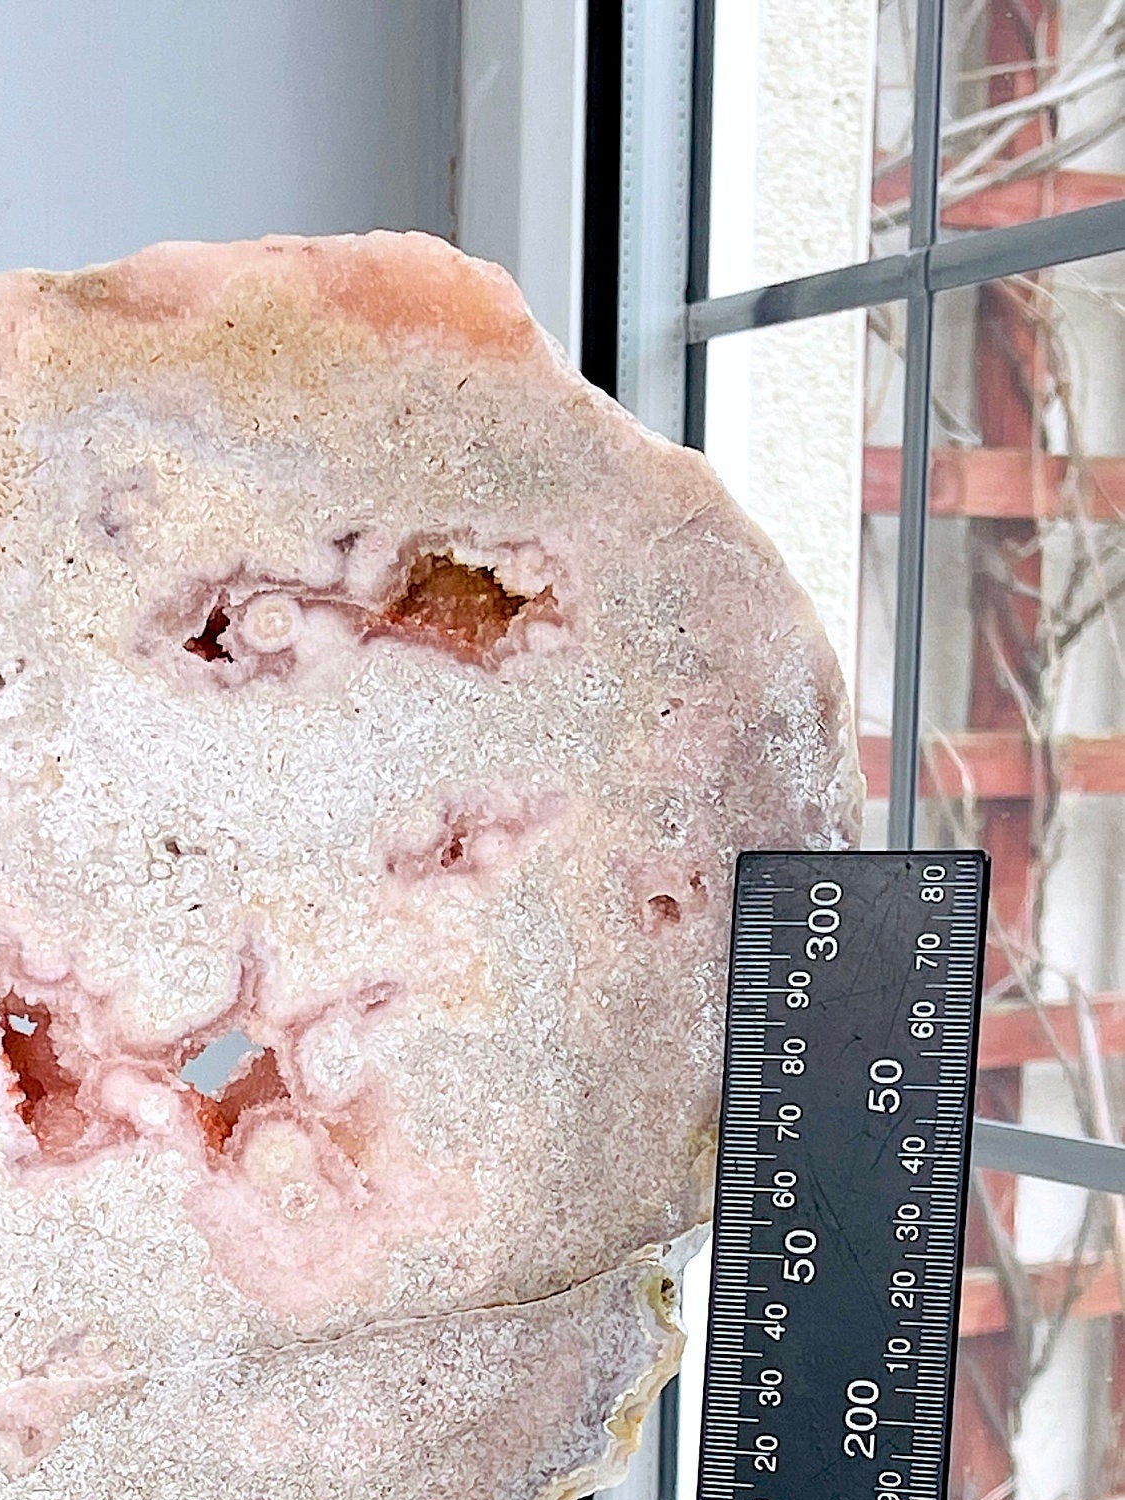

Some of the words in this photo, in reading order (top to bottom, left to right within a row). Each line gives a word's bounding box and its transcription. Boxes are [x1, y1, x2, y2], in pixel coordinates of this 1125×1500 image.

[920, 865, 946, 902] 80
[806, 881, 842, 961] 300
[915, 933, 941, 970] 70
[786, 971, 811, 1009] 90
[911, 1001, 936, 1039] 60
[781, 1038, 806, 1075] 80
[868, 1059, 903, 1114] 50
[777, 1105, 802, 1142] 70
[901, 1136, 926, 1174] 40
[773, 1171, 797, 1208] 60
[896, 1204, 921, 1241] 30
[783, 1229, 817, 1284] 50
[891, 1271, 916, 1309] 20
[764, 1304, 787, 1340] 40
[887, 1337, 912, 1372] 10
[759, 1370, 783, 1406] 30
[844, 1379, 879, 1459] 200
[755, 1435, 778, 1472] 20
